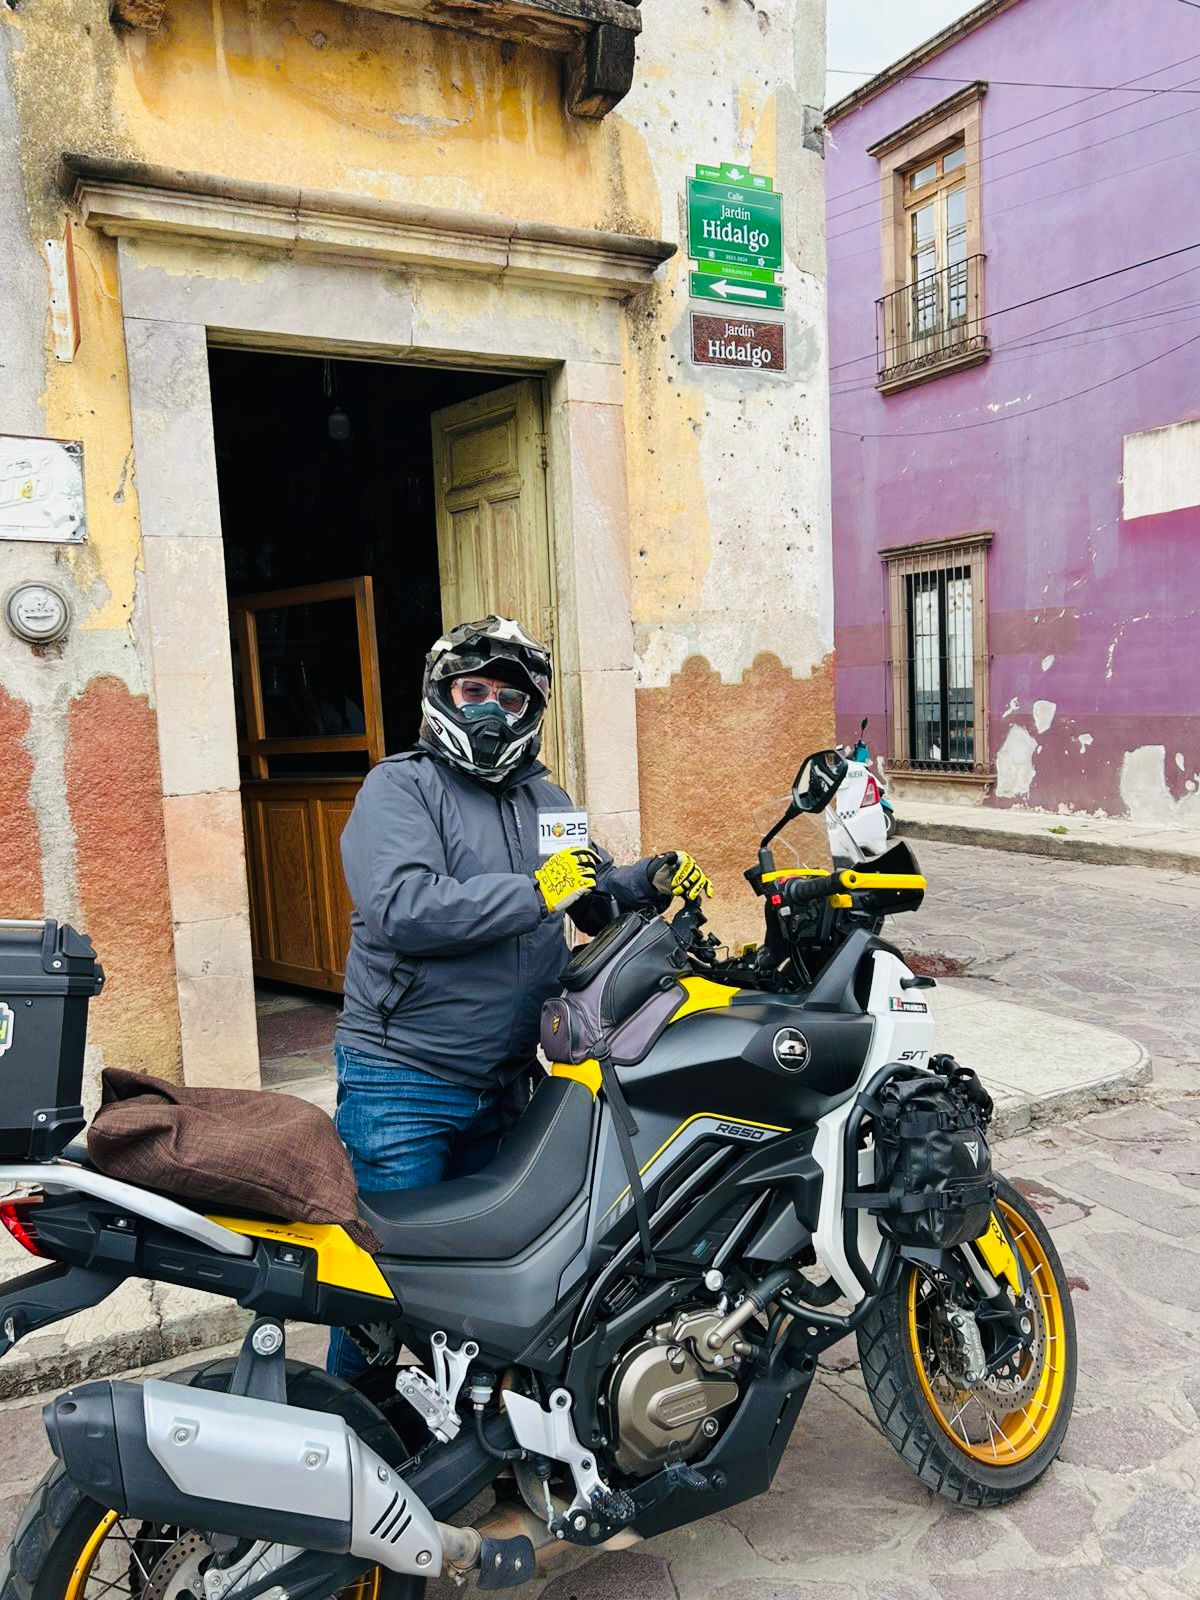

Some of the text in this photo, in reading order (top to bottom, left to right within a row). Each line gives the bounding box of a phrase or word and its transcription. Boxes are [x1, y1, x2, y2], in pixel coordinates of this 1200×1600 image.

[727, 191, 744, 202] Calle
[720, 204, 751, 221] Jardin
[702, 218, 769, 253] Hidalgo
[724, 323, 755, 338] Jardin
[707, 339, 772, 368] Hidalgo
[540, 822, 588, 837] 11 25
[897, 1050, 928, 1061] SVT
[715, 1123, 766, 1140] R650
